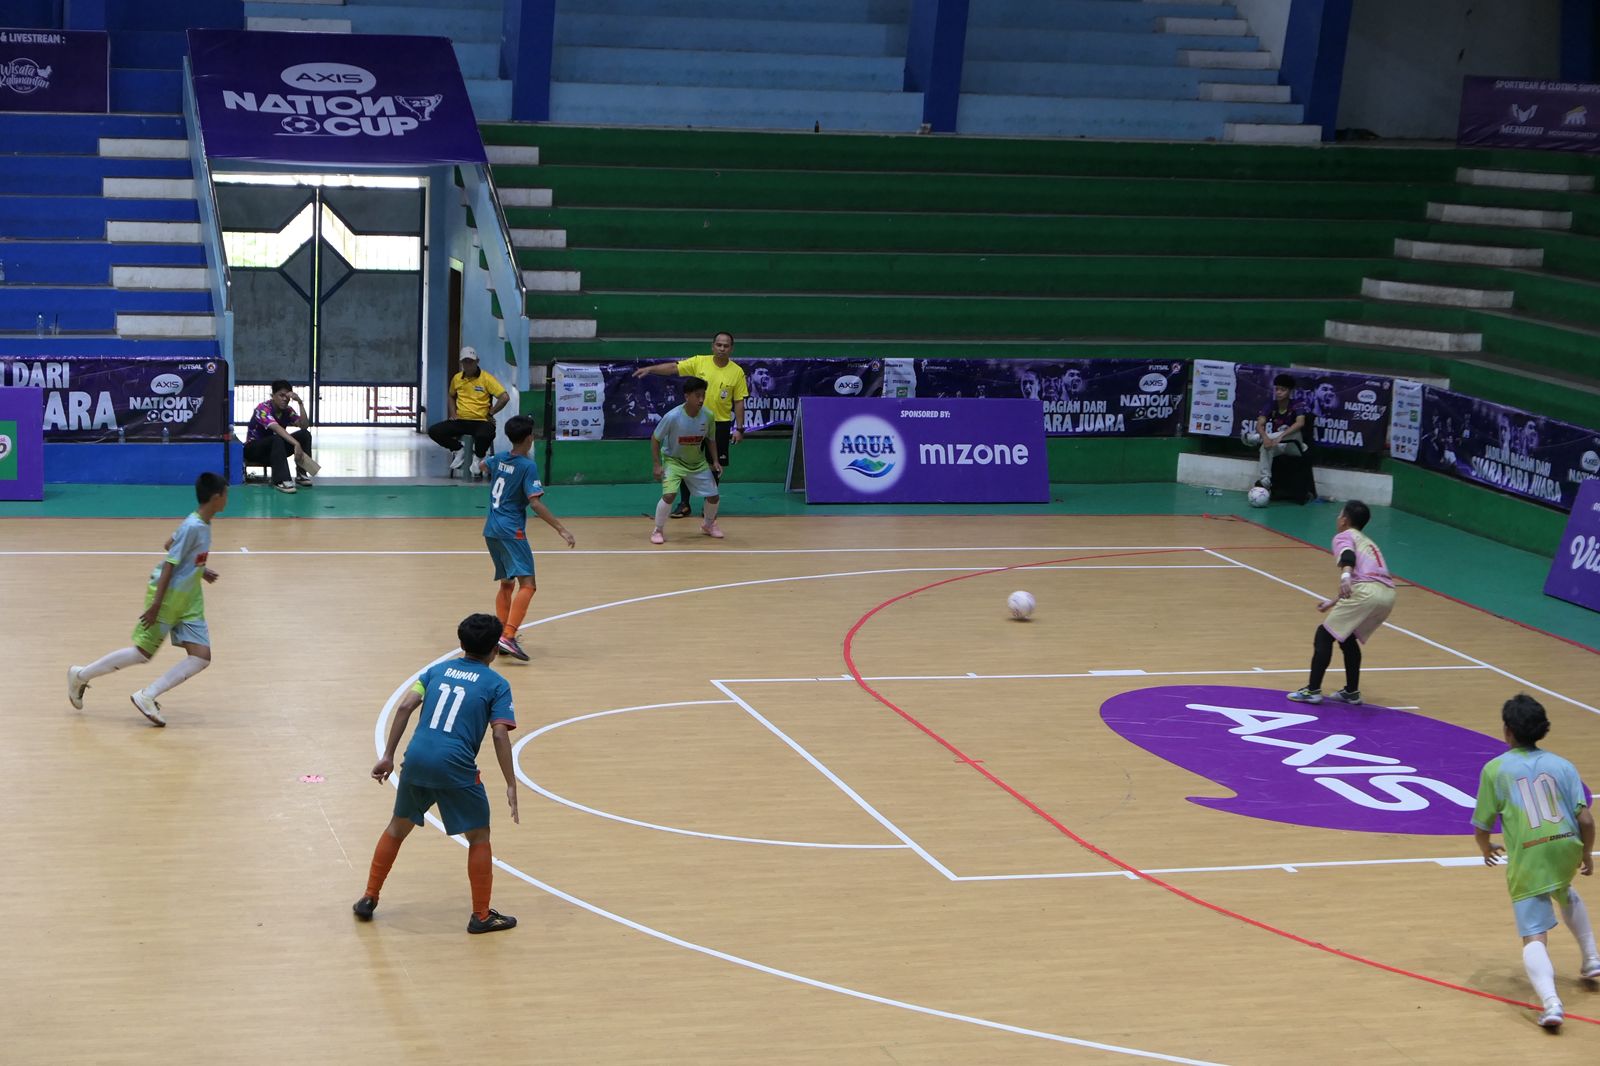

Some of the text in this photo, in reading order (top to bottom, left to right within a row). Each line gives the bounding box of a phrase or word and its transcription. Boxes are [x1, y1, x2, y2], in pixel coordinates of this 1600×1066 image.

[0, 32, 7, 42] &
[9, 33, 60, 43] LIVESTREAM
[296, 72, 363, 84] AXIS
[222, 90, 397, 116] NATION
[323, 116, 419, 136] CUP
[13, 362, 69, 388] DARI
[1143, 379, 1164, 387] AXIS
[155, 380, 179, 388] AXIS
[129, 396, 187, 410] NATION
[773, 398, 794, 410] DARI
[1083, 401, 1107, 413] DARI
[1120, 394, 1169, 406] NATION
[43, 391, 117, 431] ARA
[161, 410, 193, 423] CUP
[900, 410, 938, 418] SPONSORED
[1147, 407, 1173, 419] CUP
[1361, 411, 1381, 421] CUP
[1043, 414, 1125, 432] ARA JUARA
[840, 434, 896, 457] AQUA
[1320, 428, 1364, 447] JUARA
[919, 443, 1029, 465] mizone
[491, 476, 506, 509] 9
[444, 667, 480, 683] RAHMAN
[429, 682, 466, 733] 11
[1184, 703, 1477, 812] AXIS
[1516, 772, 1565, 829] 10
